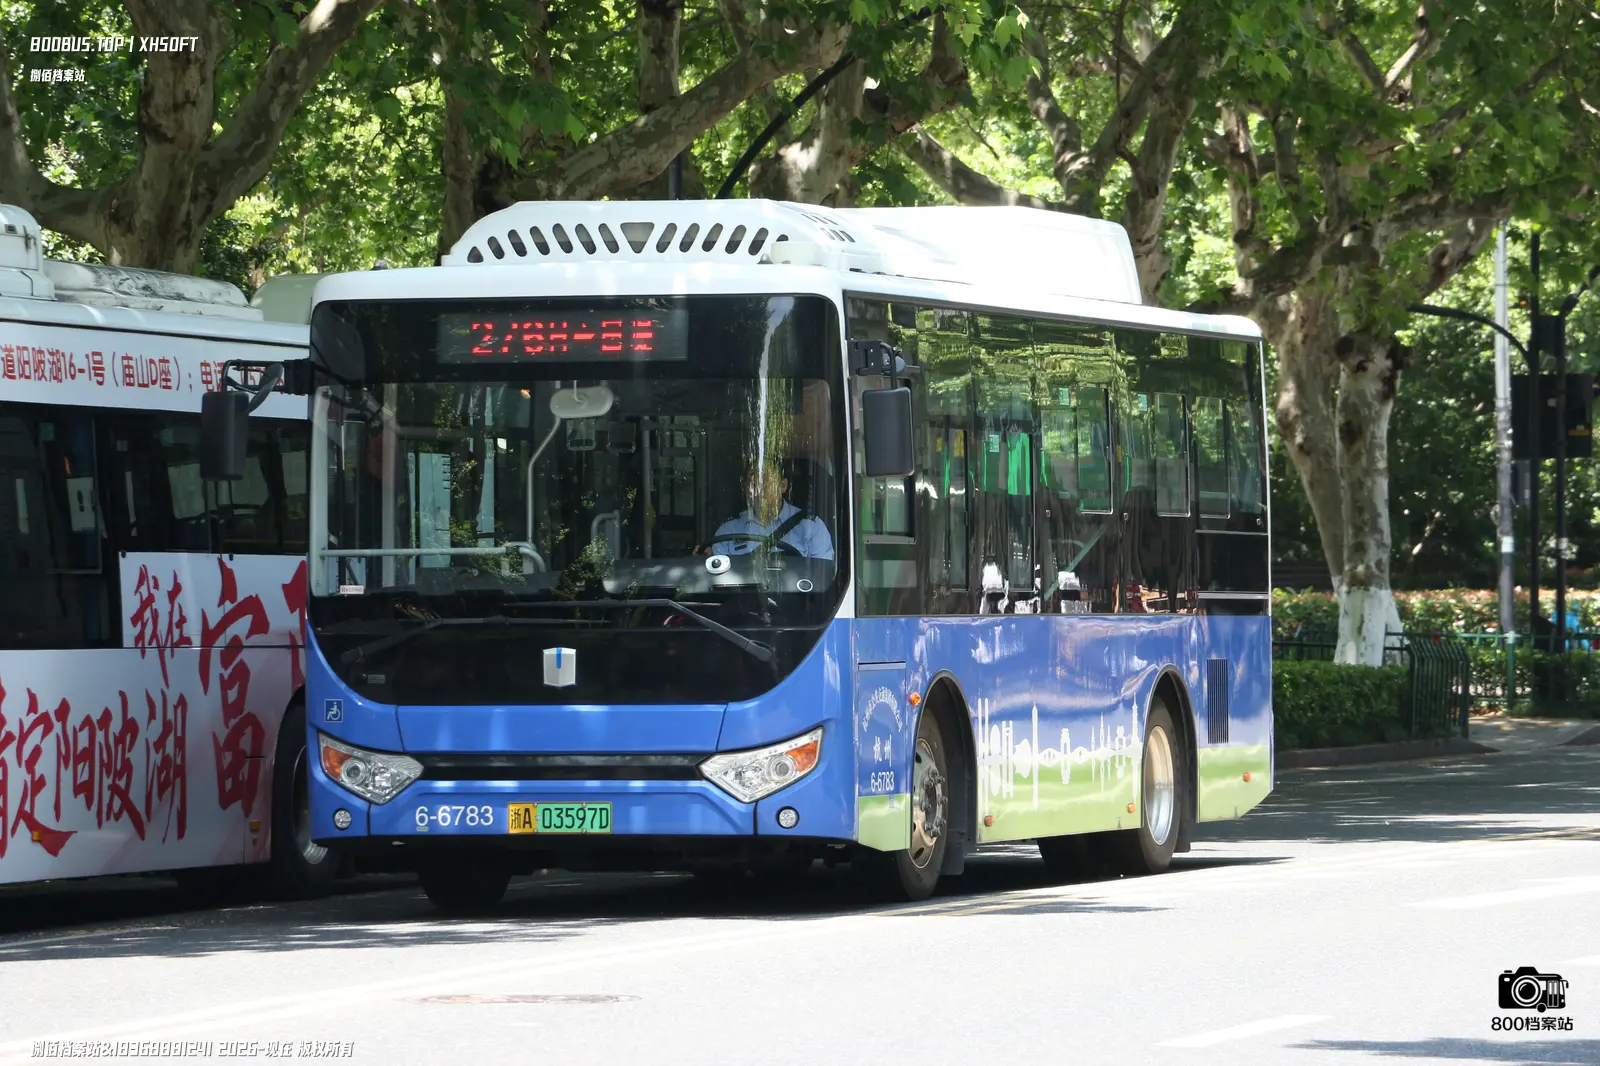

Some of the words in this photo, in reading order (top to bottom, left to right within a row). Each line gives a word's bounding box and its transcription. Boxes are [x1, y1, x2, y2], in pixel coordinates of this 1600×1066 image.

[870, 771, 895, 792] 6-6783
[415, 805, 494, 827] 6-6783
[542, 807, 610, 829] 03597D
